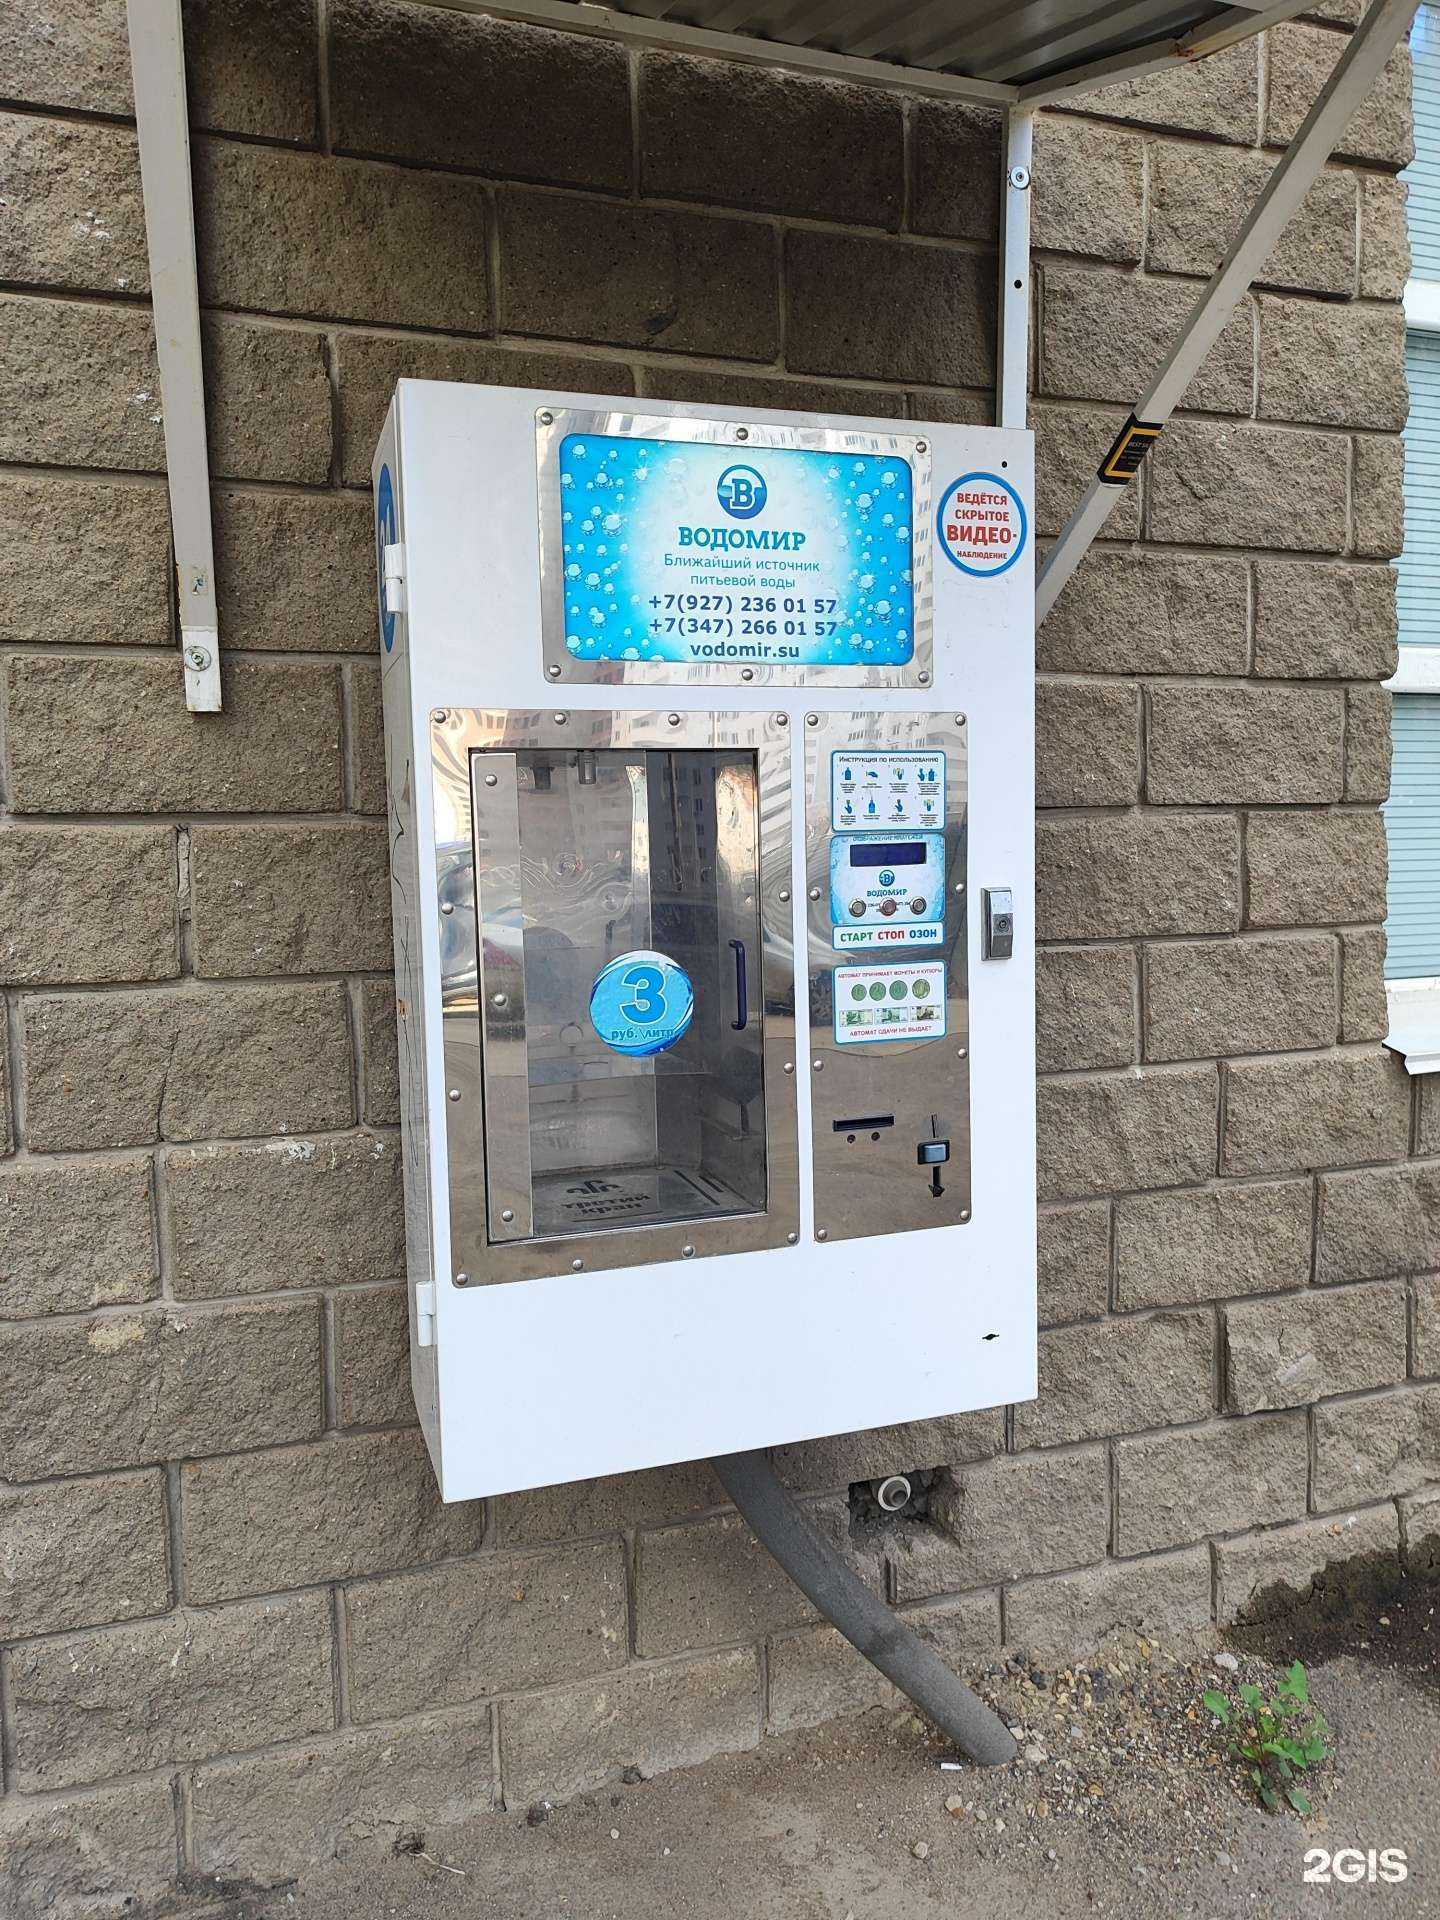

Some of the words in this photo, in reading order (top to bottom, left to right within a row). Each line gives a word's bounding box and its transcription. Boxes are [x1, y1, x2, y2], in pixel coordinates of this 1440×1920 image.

[957, 492, 1008, 506] ВЕДЁТСЯ
[955, 509, 1010, 522] СКРЫТОЕ
[678, 526, 806, 552] ВОДОМИР
[664, 553, 752, 569] Ближайший
[755, 560, 820, 572] источник
[956, 550, 1008, 560] НАБЛЮДЕНИЕ
[690, 574, 756, 587] питьевой
[760, 578, 796, 590] воды
[649, 594, 733, 614] +7(927)
[741, 597, 777, 613] 236
[783, 598, 807, 613] 01
[814, 599, 837, 614] 57
[650, 617, 734, 637] +7(347)
[741, 620, 777, 635] 266
[784, 621, 807, 636] 01
[814, 622, 838, 636] 57
[690, 642, 800, 658] vodomir.su
[867, 889, 908, 897] ВОДОМИР
[840, 932, 873, 942] СТАРТ
[878, 930, 905, 940] СТОП
[909, 929, 937, 938] ОЗОН
[620, 965, 667, 1025] 3
[611, 1027, 638, 1041] руб.
[850, 1029, 877, 1037] АВТОМАТ
